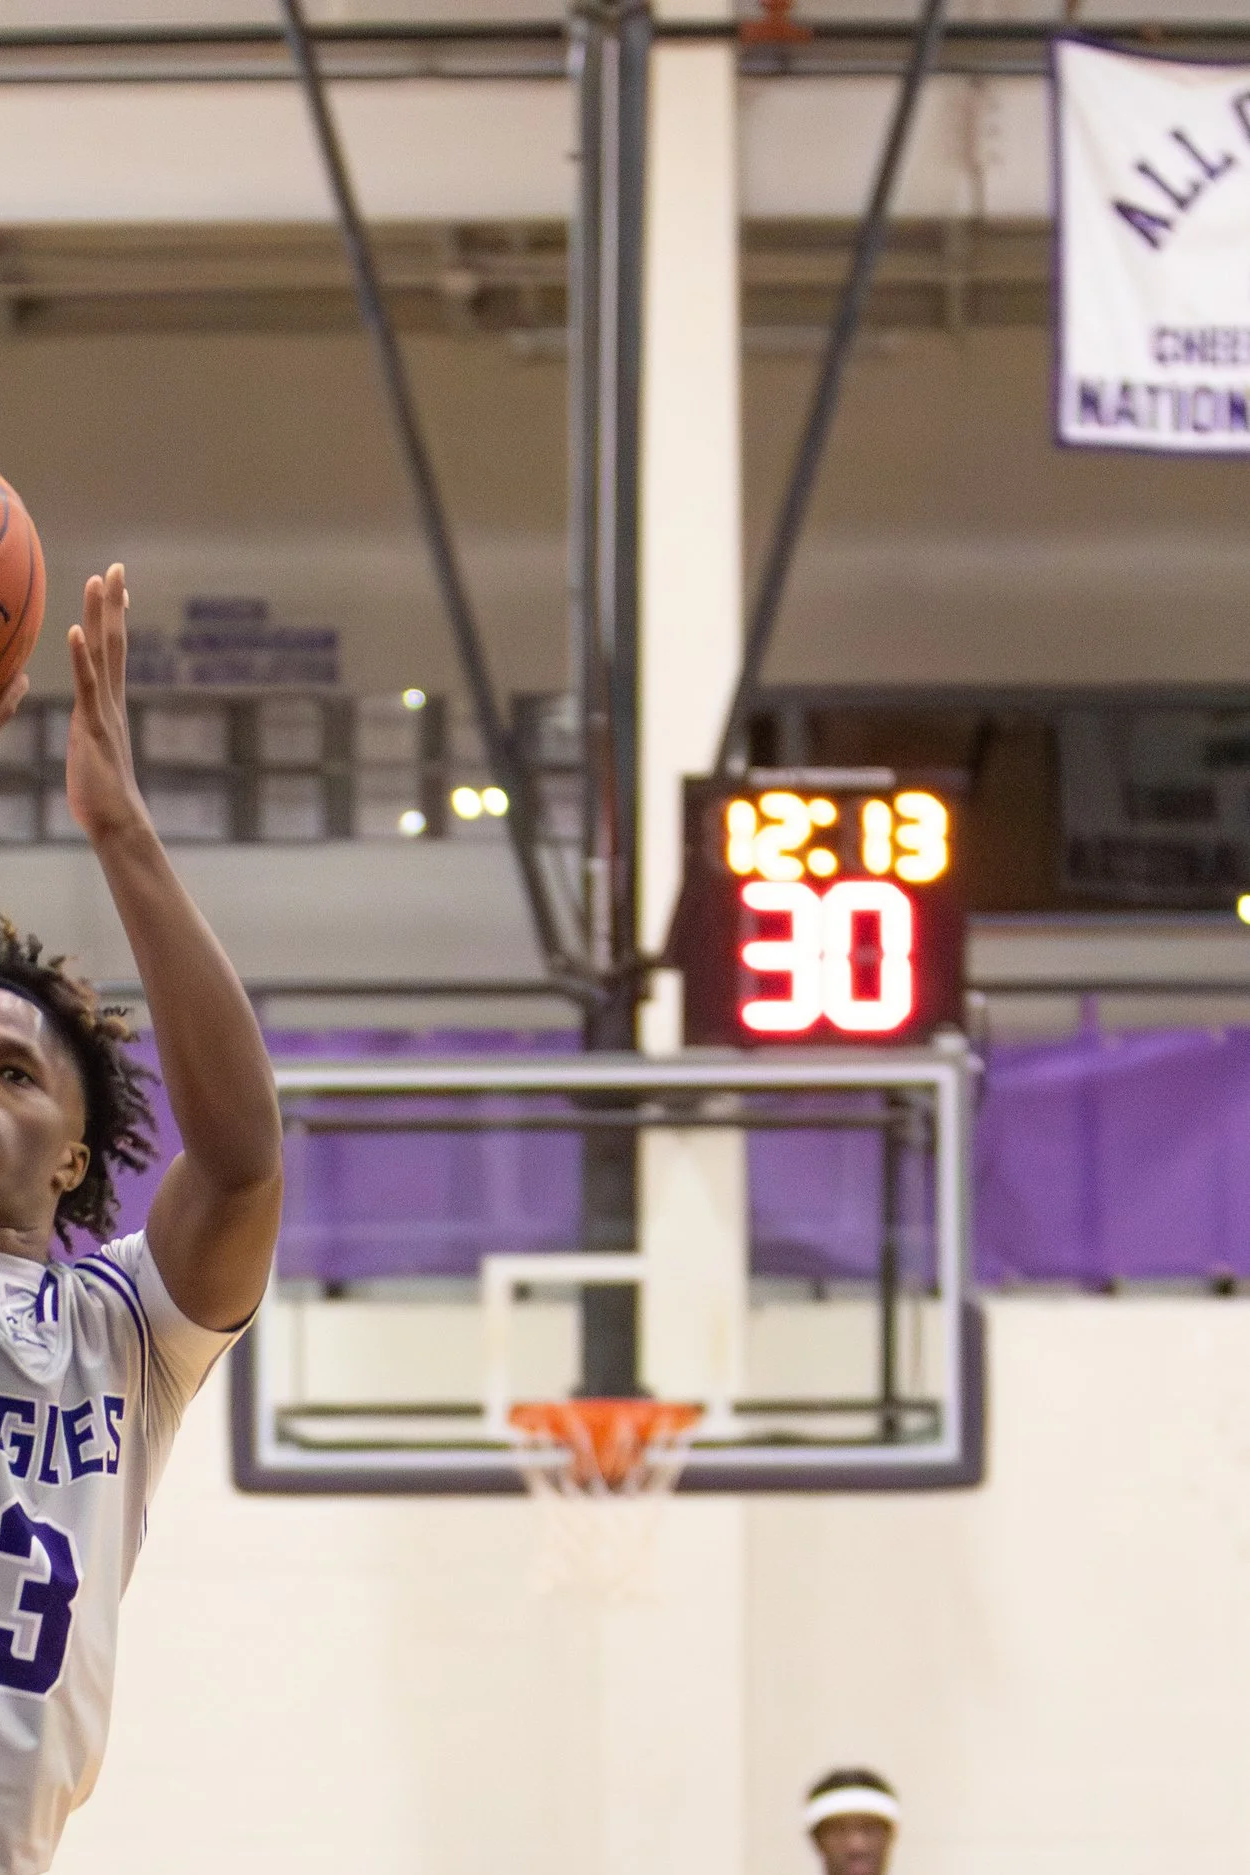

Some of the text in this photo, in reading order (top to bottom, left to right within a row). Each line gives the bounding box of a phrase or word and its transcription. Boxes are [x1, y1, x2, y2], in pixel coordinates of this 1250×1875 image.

[1112, 128, 1236, 252] ALL
[724, 790, 949, 884] 12:13
[740, 880, 913, 1033] 30
